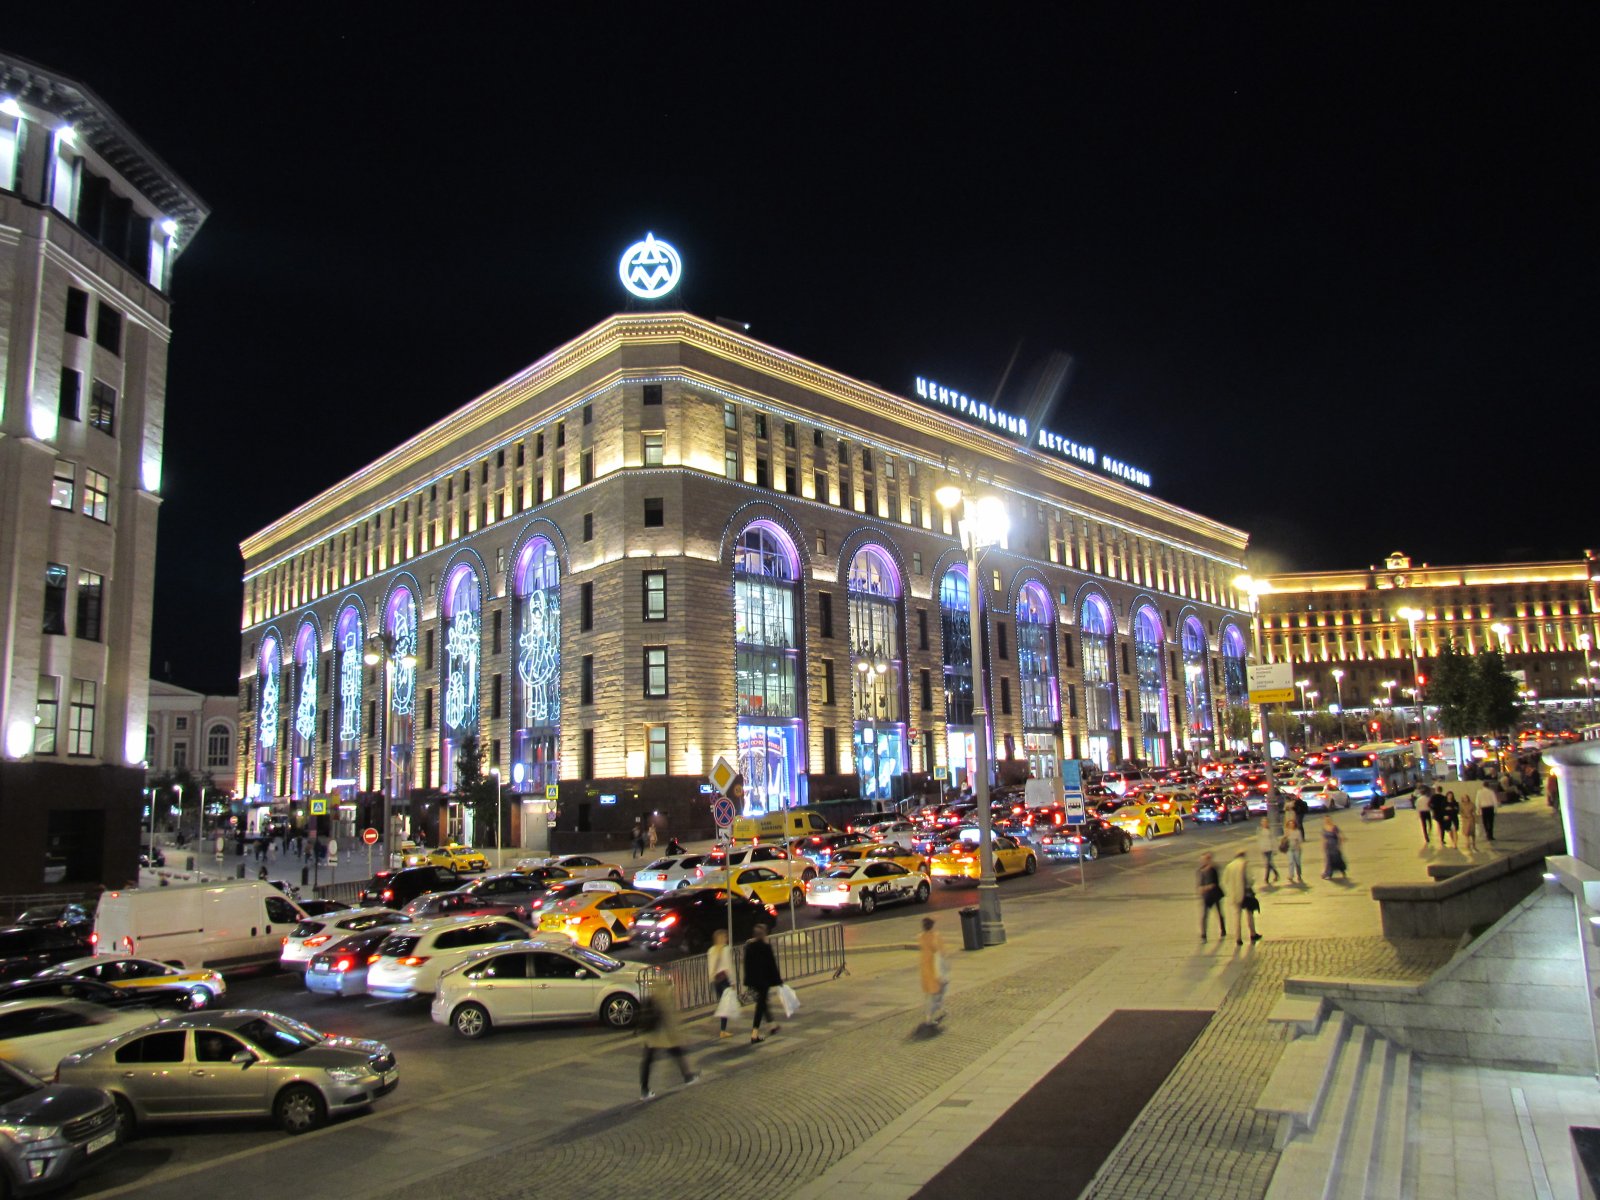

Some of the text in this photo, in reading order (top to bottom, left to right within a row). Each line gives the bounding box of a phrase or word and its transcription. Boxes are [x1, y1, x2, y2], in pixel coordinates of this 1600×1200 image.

[915, 377, 1151, 488] ЦЕНТРАЛЬНЫЙ ДЕТСКИЙ МАГАЗИН
